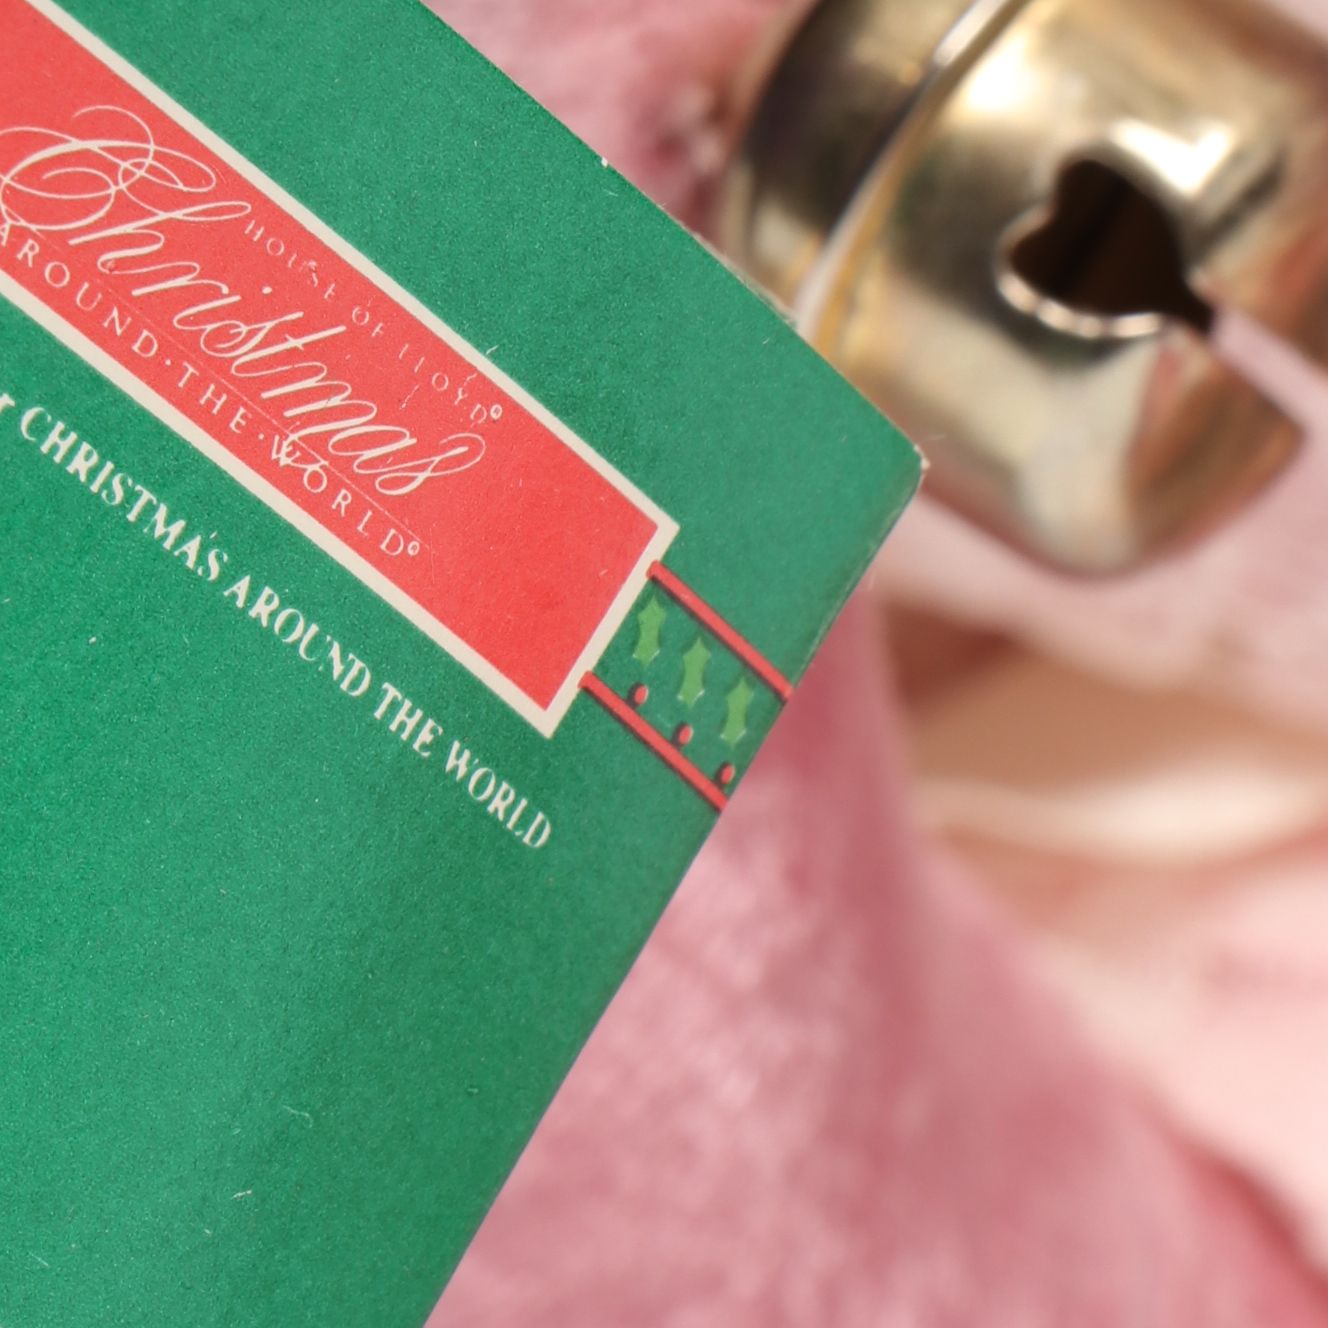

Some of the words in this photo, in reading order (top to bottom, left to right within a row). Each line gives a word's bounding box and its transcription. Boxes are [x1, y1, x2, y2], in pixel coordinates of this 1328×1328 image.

[176, 367, 260, 435] THE
[20, 406, 229, 583] CHRISTMAS
[223, 574, 373, 699] AROUND
[372, 682, 444, 759] THE
[444, 739, 553, 851] WORLD
